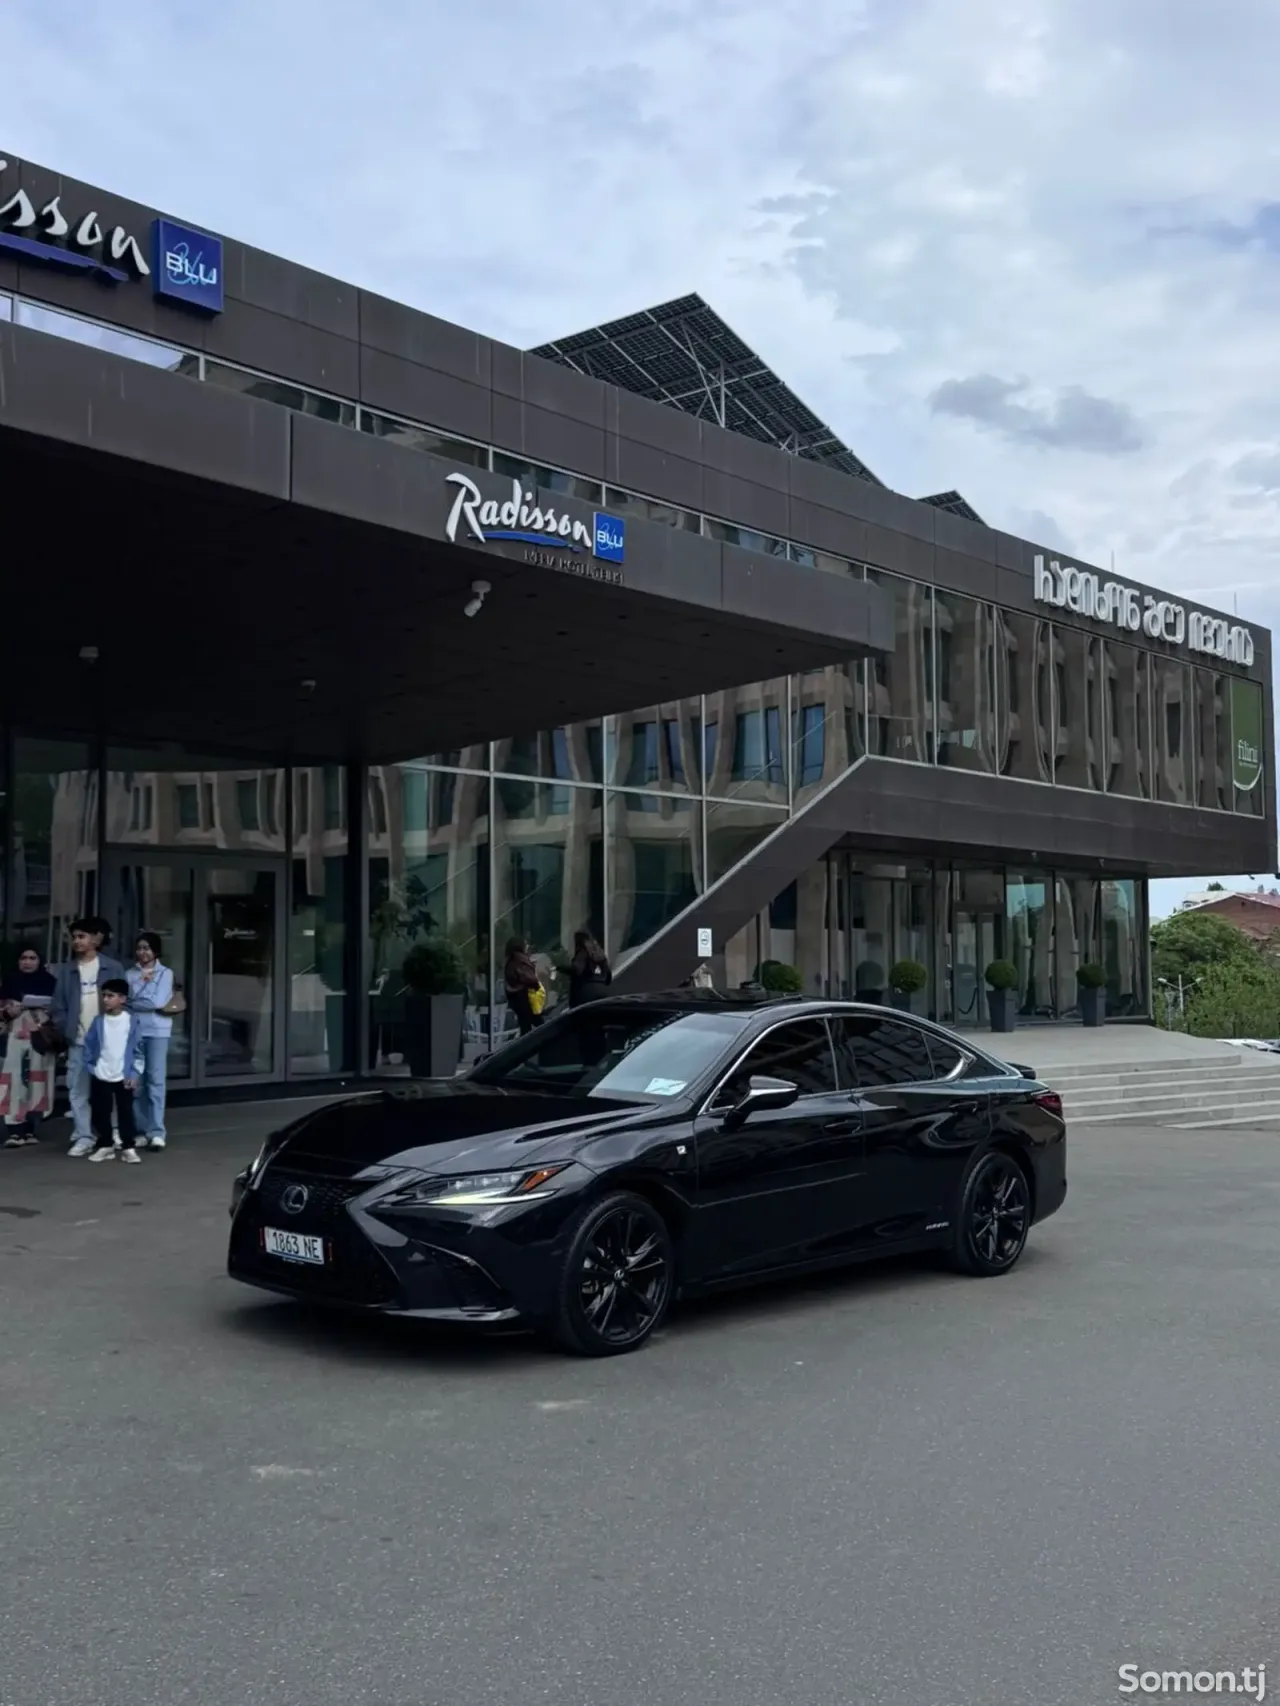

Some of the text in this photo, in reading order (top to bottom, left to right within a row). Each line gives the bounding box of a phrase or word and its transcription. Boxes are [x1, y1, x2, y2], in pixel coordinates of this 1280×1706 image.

[0, 160, 218, 286] sson BLU
[444, 472, 624, 549] Radisson BLU
[272, 1231, 320, 1259] 1863 NE
